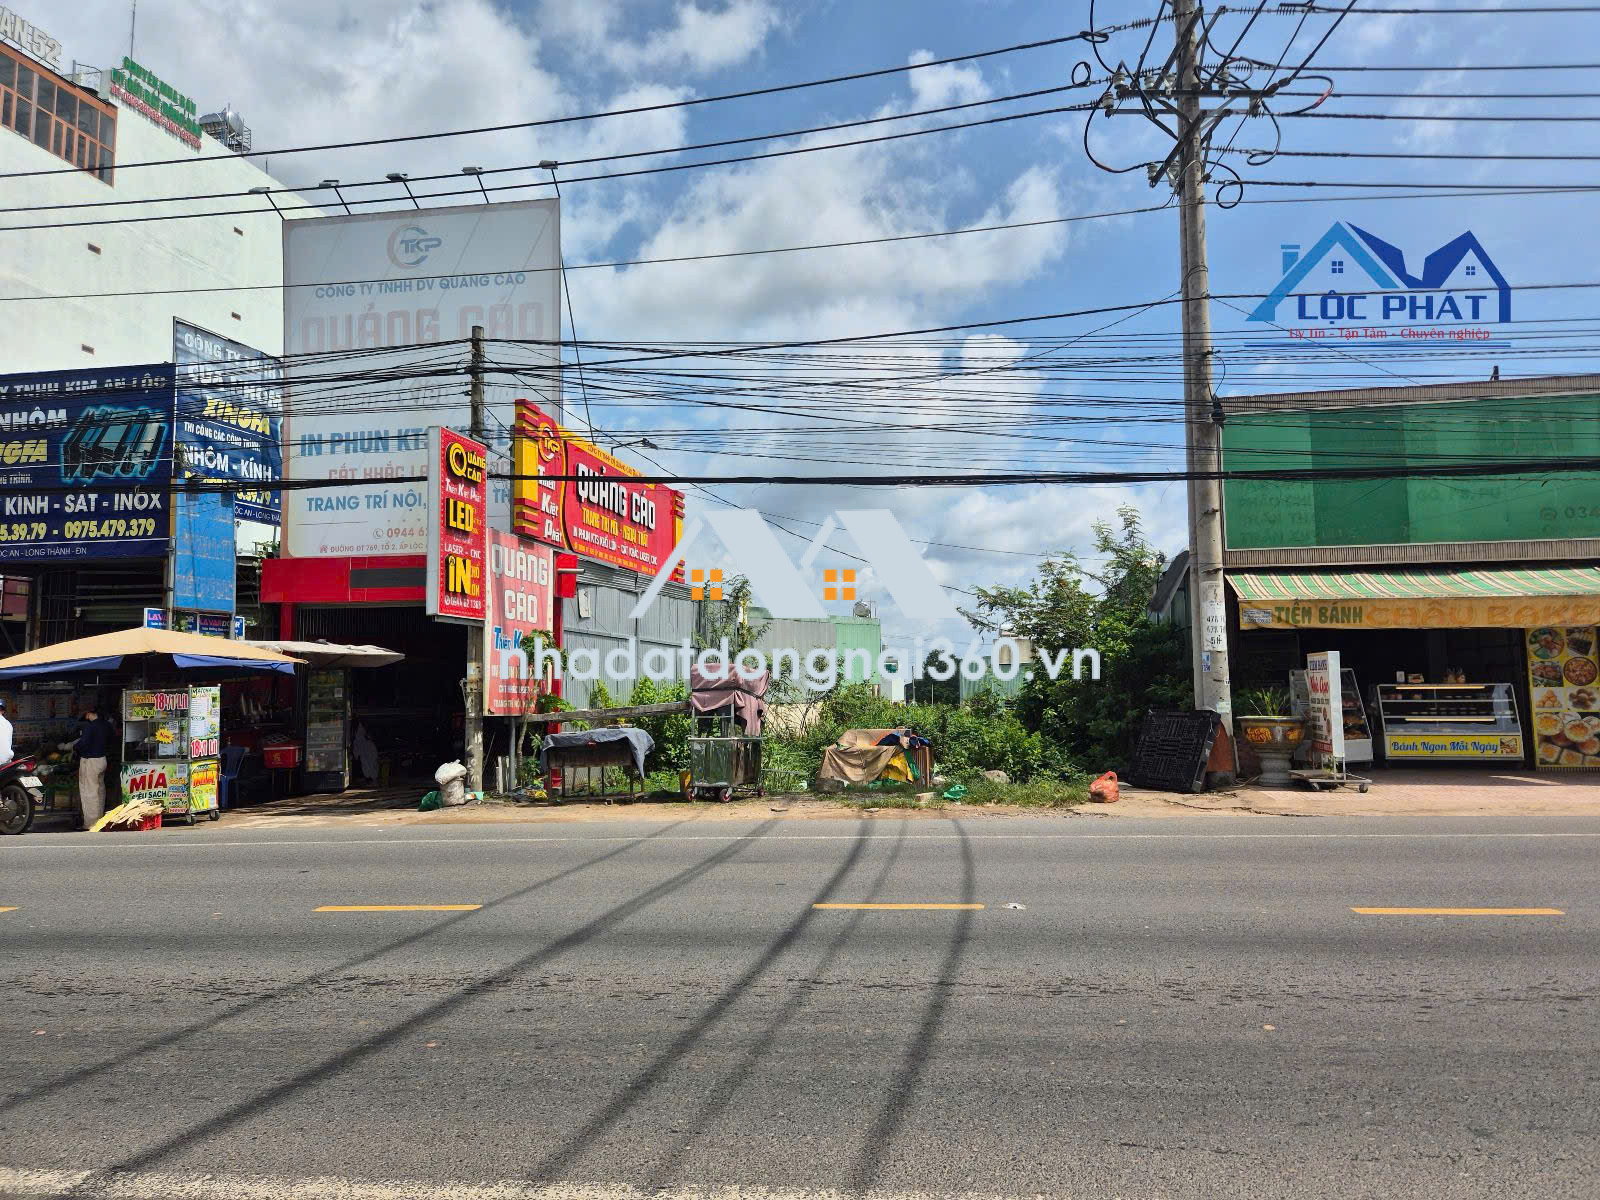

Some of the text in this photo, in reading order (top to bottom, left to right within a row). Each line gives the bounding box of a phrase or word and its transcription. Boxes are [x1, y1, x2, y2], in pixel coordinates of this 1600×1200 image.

[31, 27, 63, 71] 52
[315, 284, 355, 298] CÔNG
[360, 283, 374, 295] TY
[378, 280, 412, 294] TNHH
[416, 279, 435, 291] DV
[184, 331, 221, 360] CÔNG
[65, 380, 98, 393] KIM
[301, 433, 323, 456] IN
[330, 430, 389, 455] PHUN
[240, 456, 272, 482] KÍNH
[114, 493, 162, 511] INOX
[306, 495, 360, 512] TRANG
[365, 490, 388, 508] TRÍ
[576, 463, 628, 516] QUẢNG
[632, 490, 656, 530] CÁO
[449, 498, 474, 532] LED
[64, 518, 156, 539] 0975.479.379
[386, 527, 415, 538] 0944
[491, 543, 548, 586] QUẢNG
[504, 587, 538, 624] CÁO
[1318, 602, 1363, 624] BÁNH
[1391, 740, 1419, 751] Bánh
[1421, 741, 1447, 753] Ngon
[1450, 740, 1469, 751] Mỗi
[129, 769, 168, 794] MÍA
